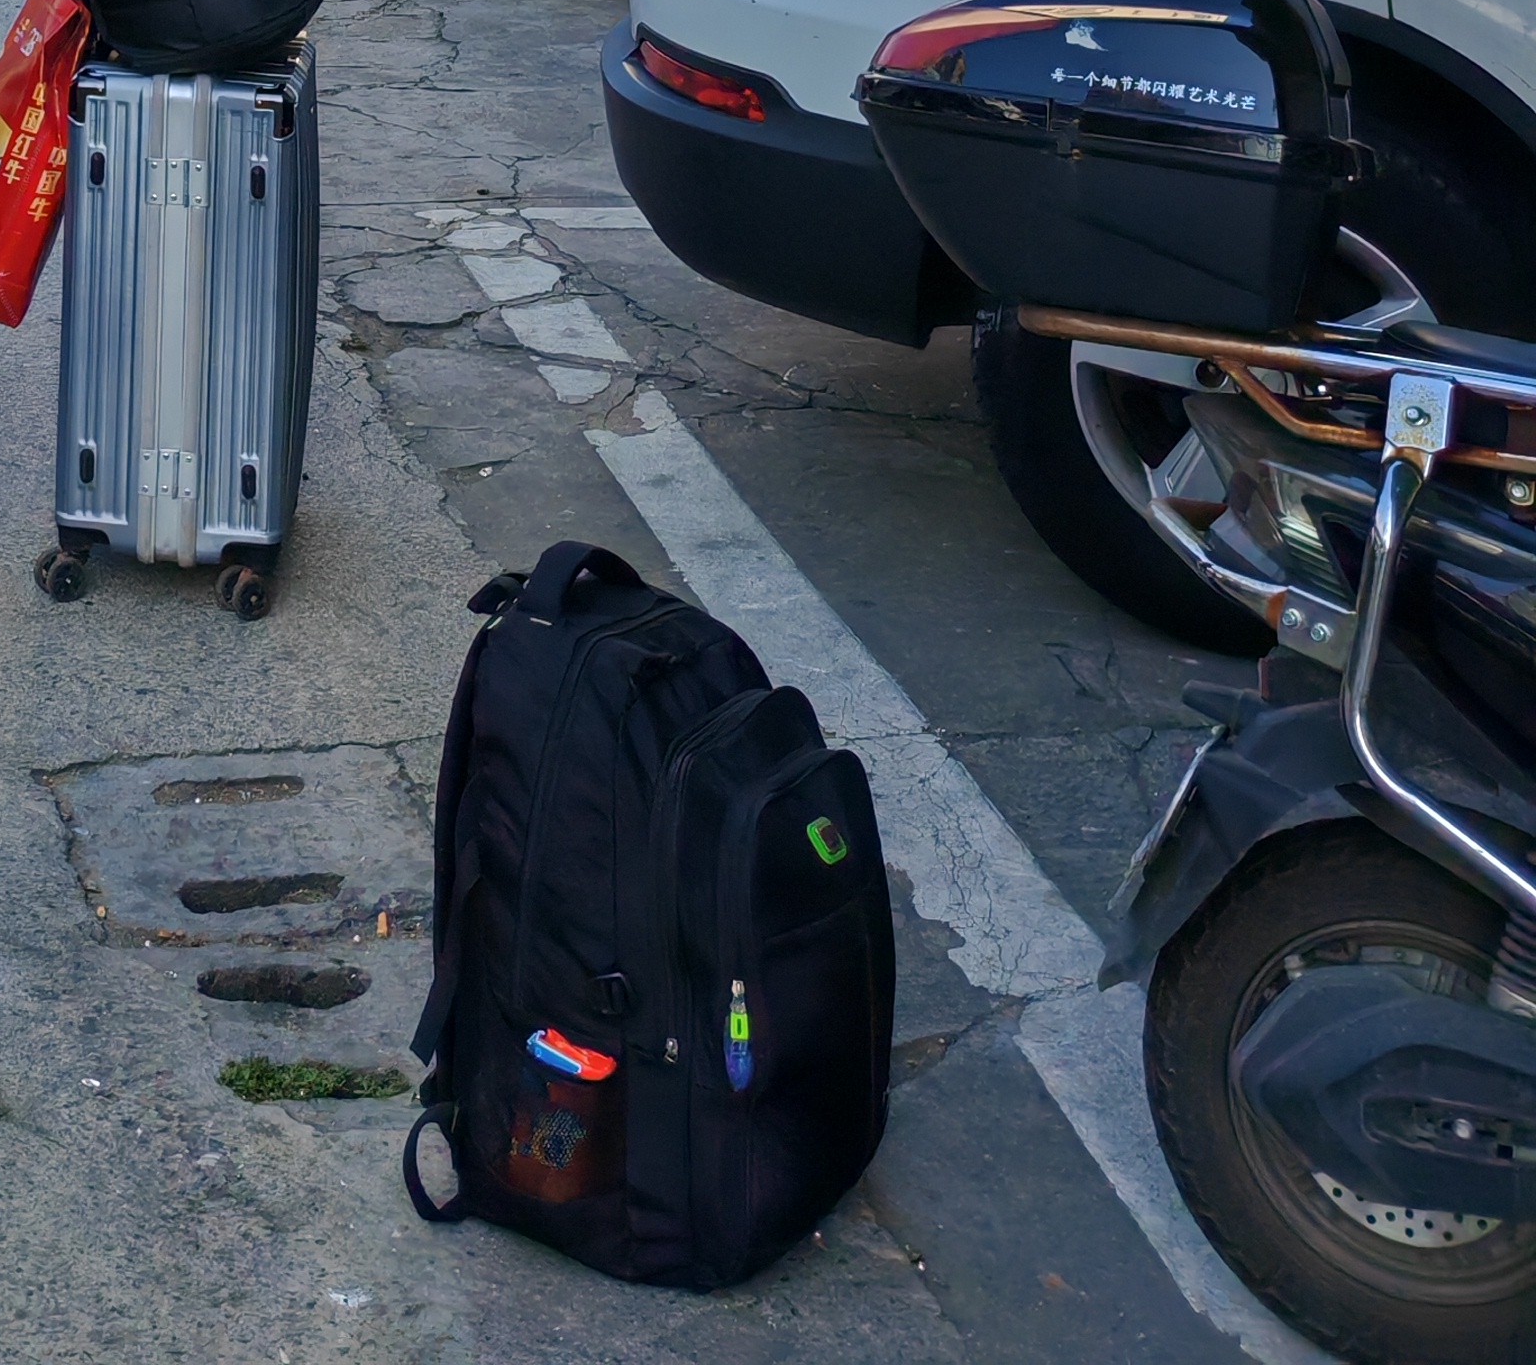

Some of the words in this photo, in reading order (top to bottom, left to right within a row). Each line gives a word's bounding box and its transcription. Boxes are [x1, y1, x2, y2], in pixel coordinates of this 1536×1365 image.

[1051, 67, 1257, 111] 每一个细节都闪耀艺术光芒
[2, 82, 47, 185] 中国红牛
